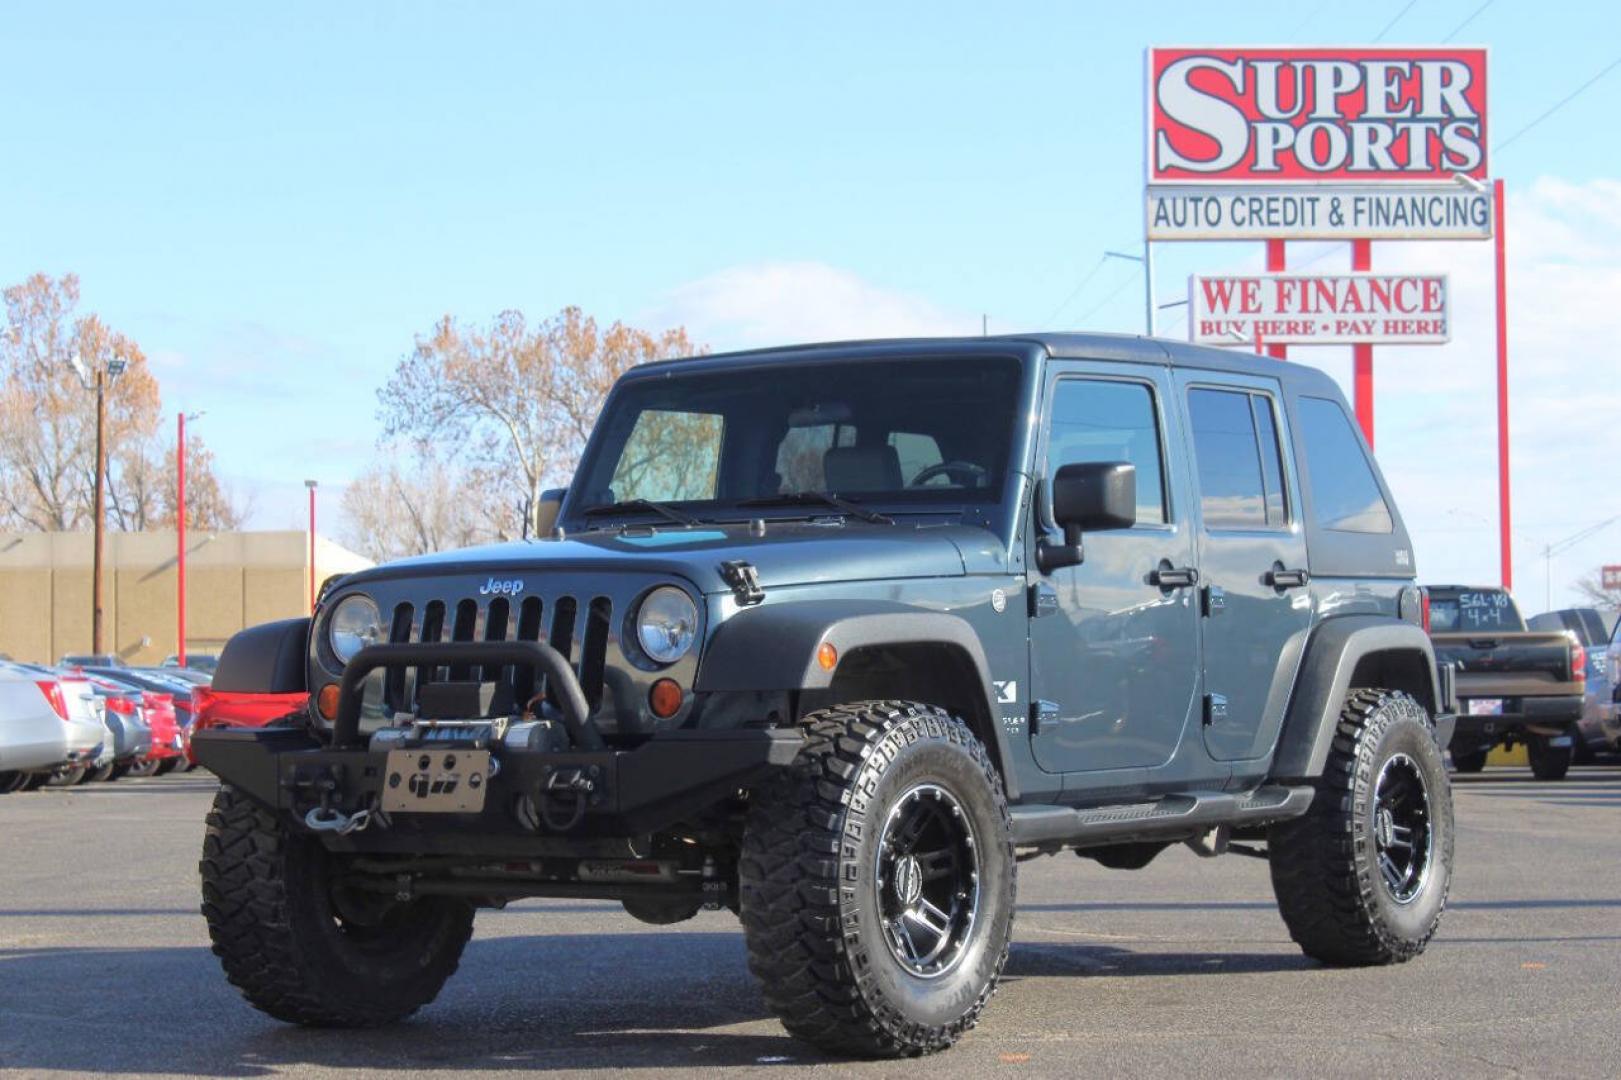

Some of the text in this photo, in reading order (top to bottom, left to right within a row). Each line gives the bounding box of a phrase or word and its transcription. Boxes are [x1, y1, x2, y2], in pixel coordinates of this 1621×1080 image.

[1156, 55, 1479, 174] SUPER
[1153, 195, 1489, 228] AUTO CREDIT & FINANCING
[1200, 277, 1445, 315] WE FINANCE
[1200, 320, 1447, 336] BUY HERE PAY HERE
[480, 577, 524, 596] Jeep
